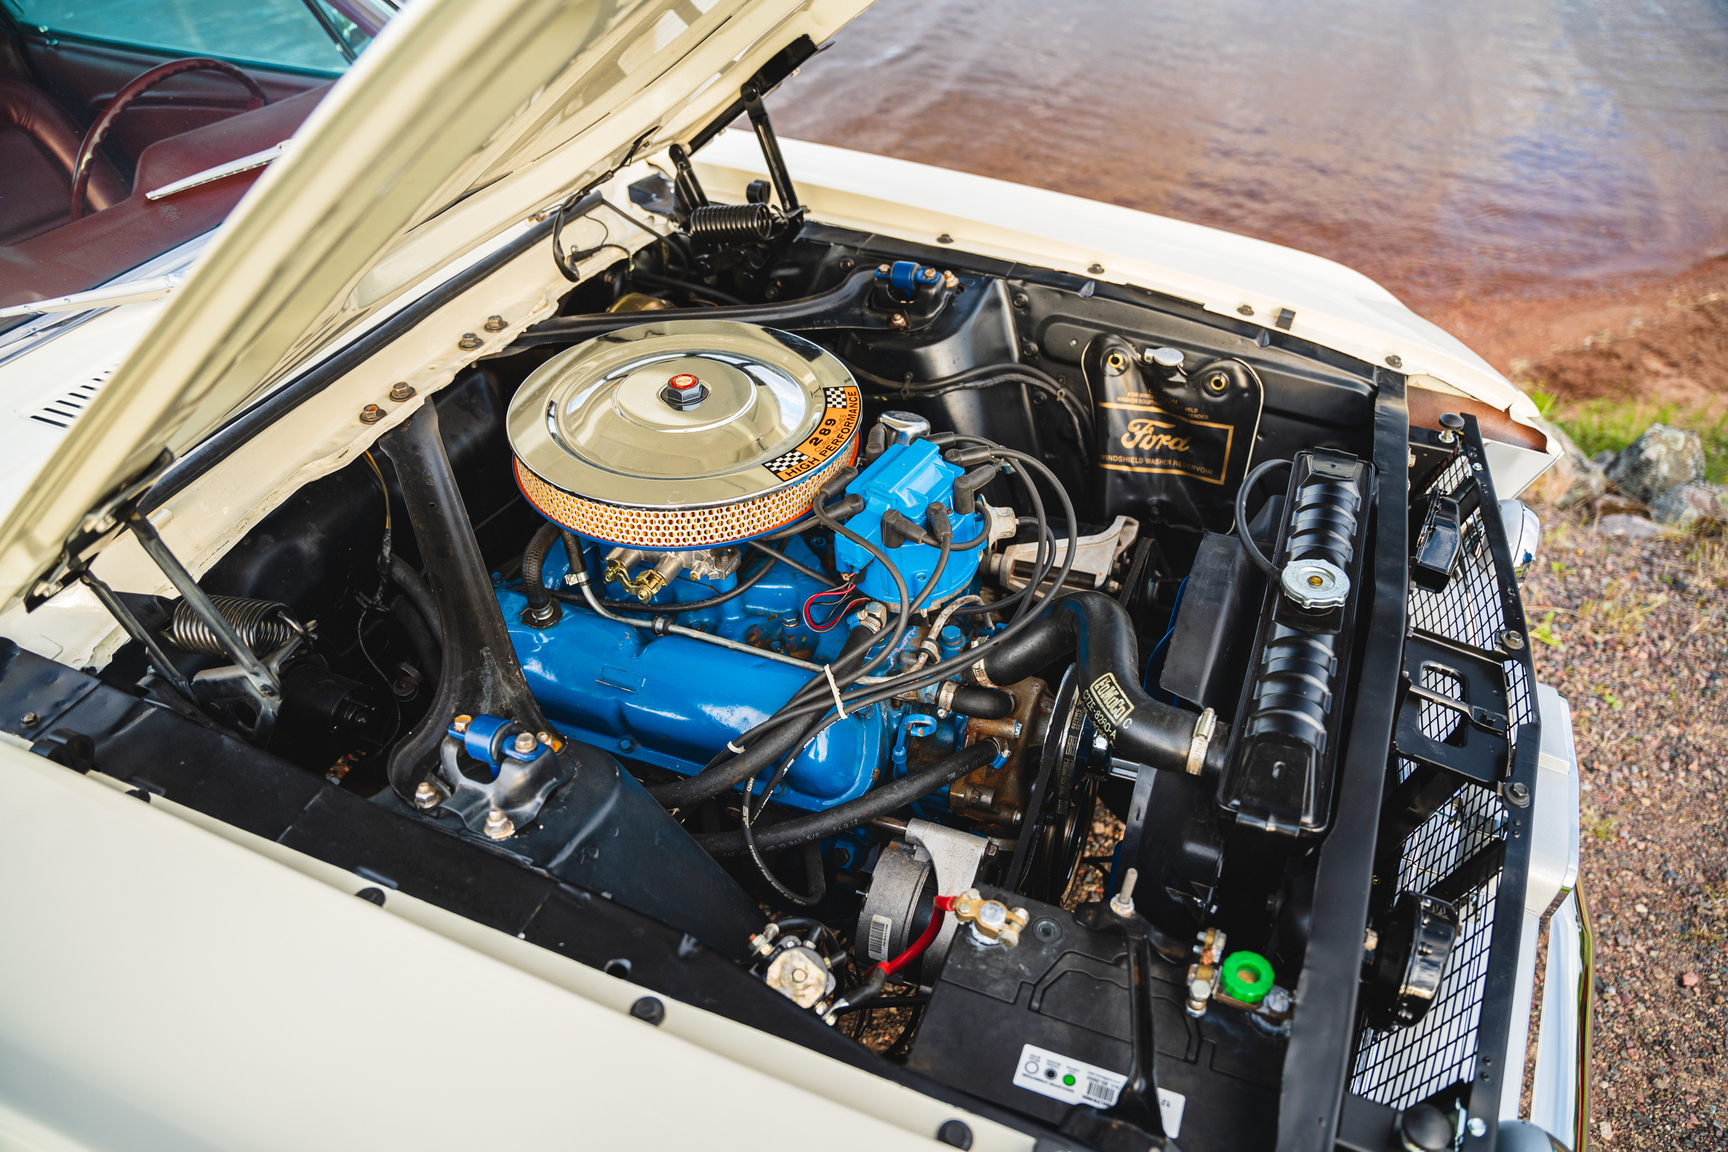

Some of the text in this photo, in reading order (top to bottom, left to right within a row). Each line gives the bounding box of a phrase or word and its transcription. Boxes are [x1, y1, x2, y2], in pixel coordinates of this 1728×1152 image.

[785, 390, 858, 477] HIGH PERFORMANCE
[808, 418, 836, 447] 289
[1121, 418, 1192, 452] Ford
[1100, 454, 1213, 475] WINDSHIELD WASHER RESERVOIR
